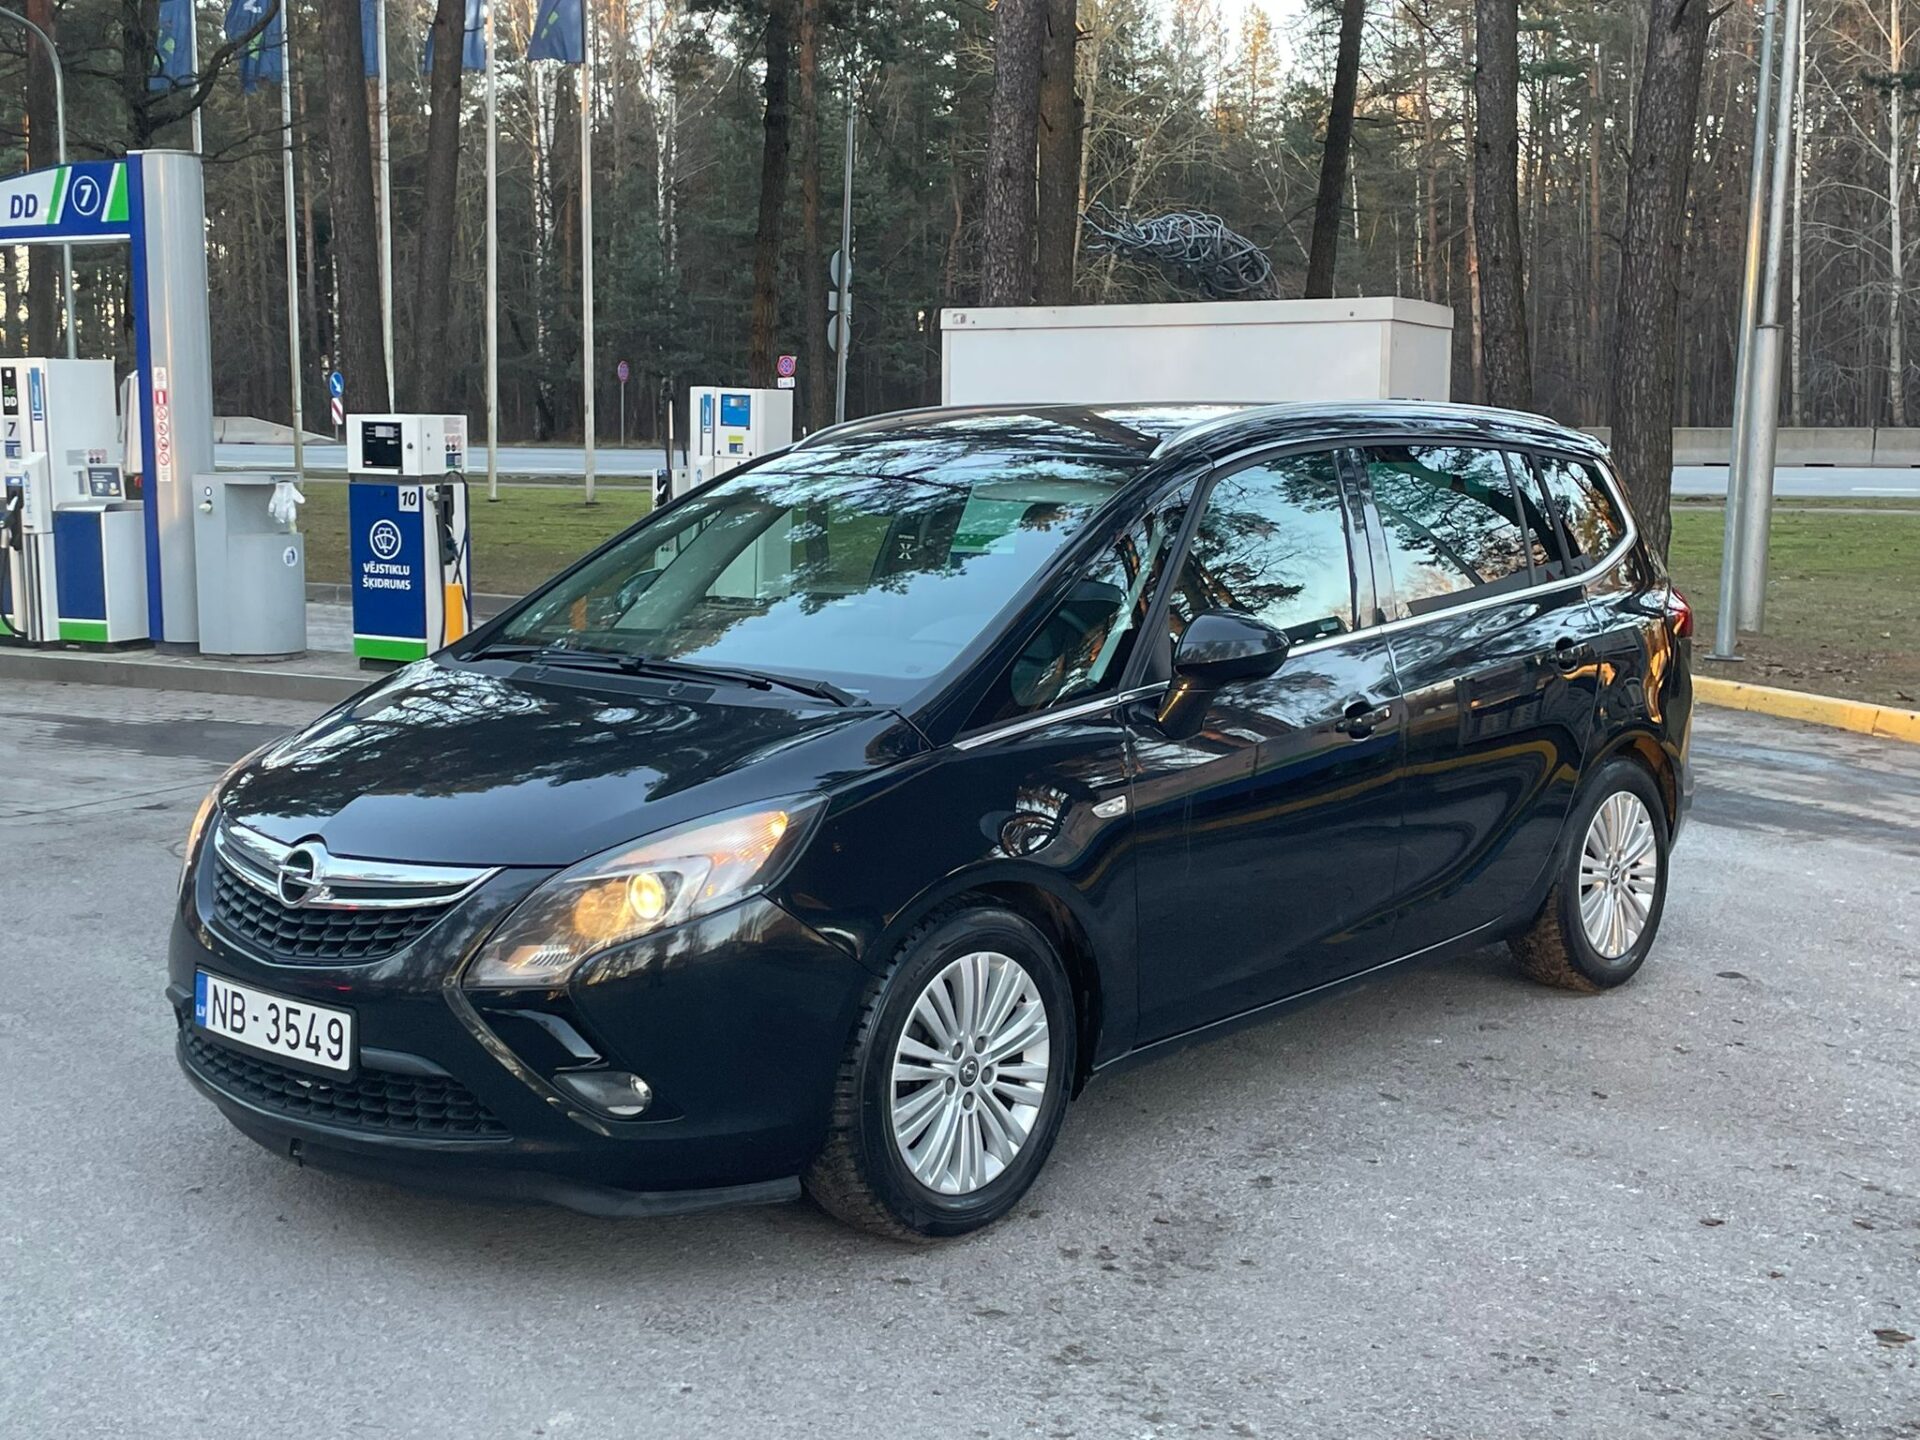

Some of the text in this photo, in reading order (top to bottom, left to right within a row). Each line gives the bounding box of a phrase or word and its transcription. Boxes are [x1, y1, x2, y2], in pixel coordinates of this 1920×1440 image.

[80, 185, 92, 207] 7
[10, 194, 38, 219] DD
[8, 422, 16, 437] 7
[402, 491, 417, 507] 10
[363, 561, 410, 576] VĒJSTIKLU
[362, 575, 411, 590] ŠĶIDRUMS
[212, 984, 344, 1061] NB-3549
